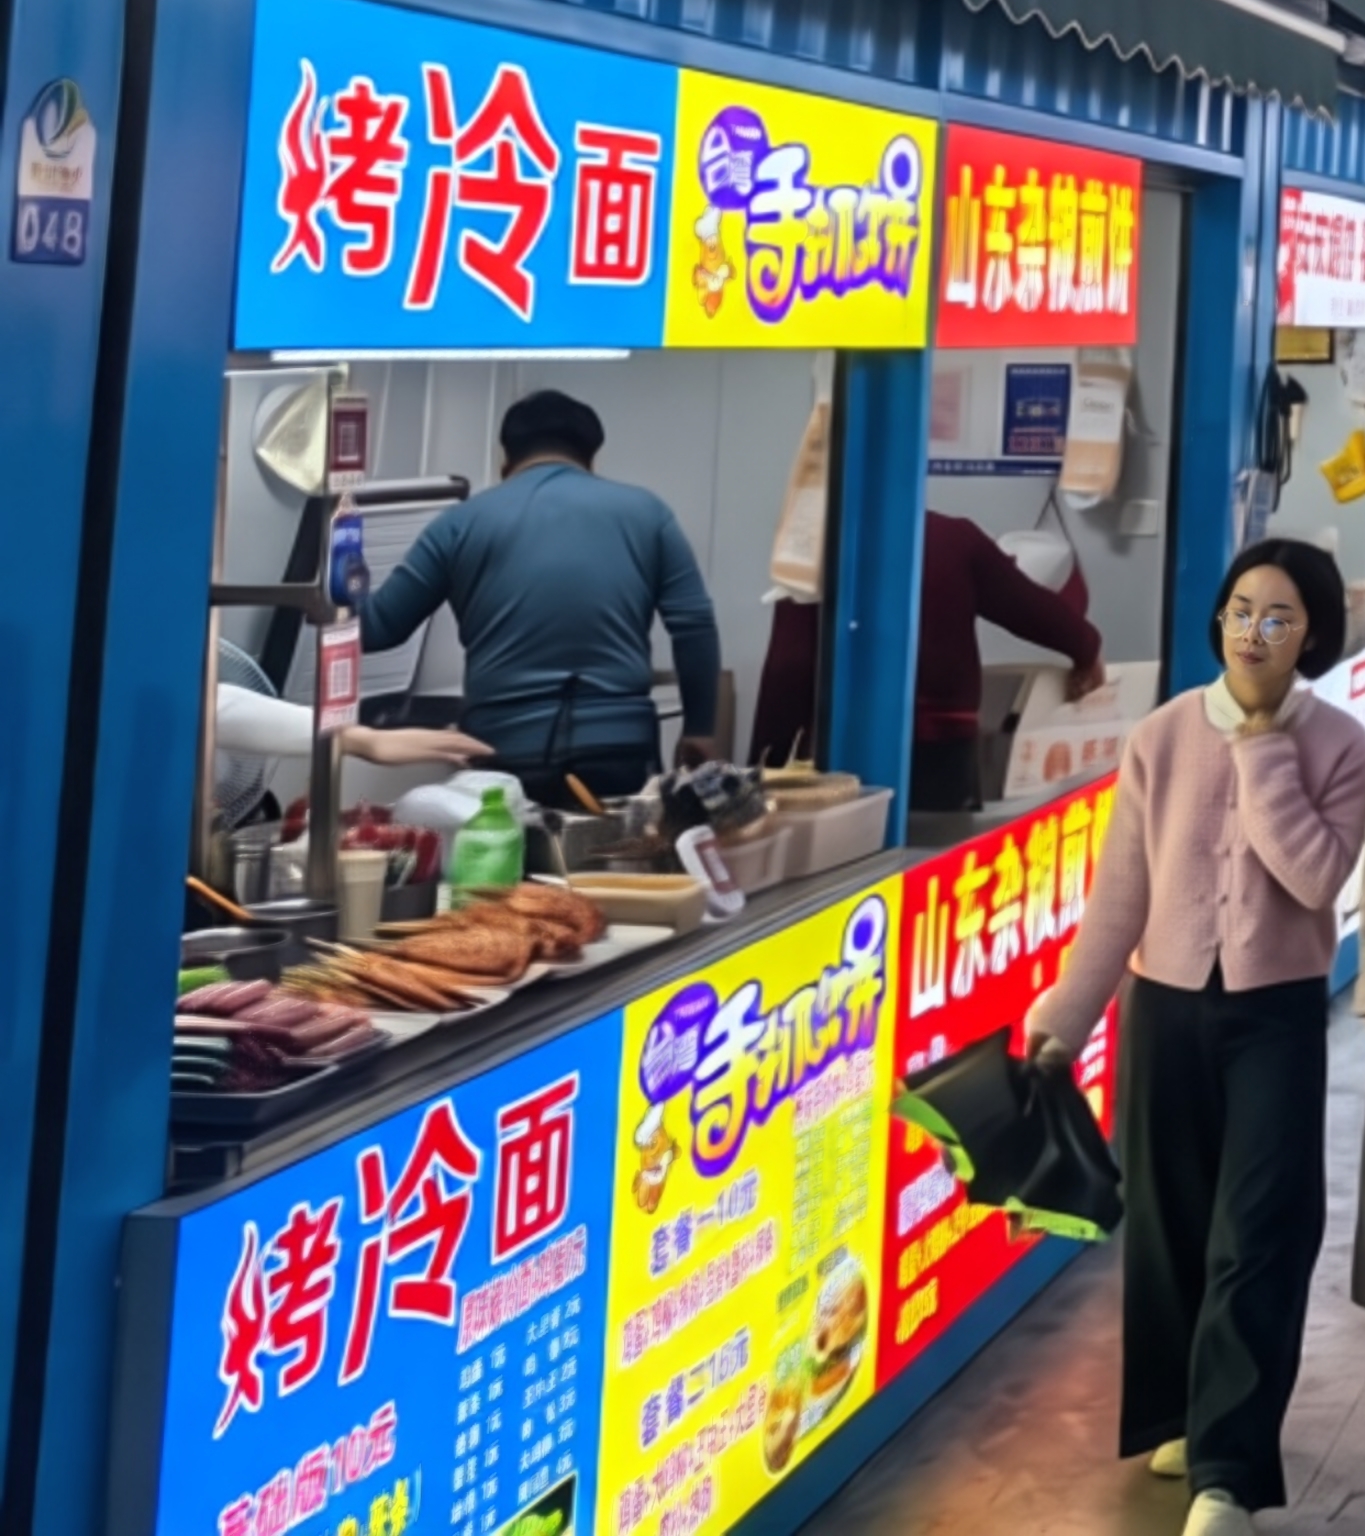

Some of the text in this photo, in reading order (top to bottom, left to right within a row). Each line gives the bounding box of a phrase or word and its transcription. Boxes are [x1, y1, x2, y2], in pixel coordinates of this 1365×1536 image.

[18, 202, 83, 259] 048
[271, 57, 661, 323] 烤冷面
[746, 135, 921, 324] 手抓饼
[946, 165, 1134, 314] 山东杂粮煎饼
[213, 1071, 580, 1440] 烤冷面
